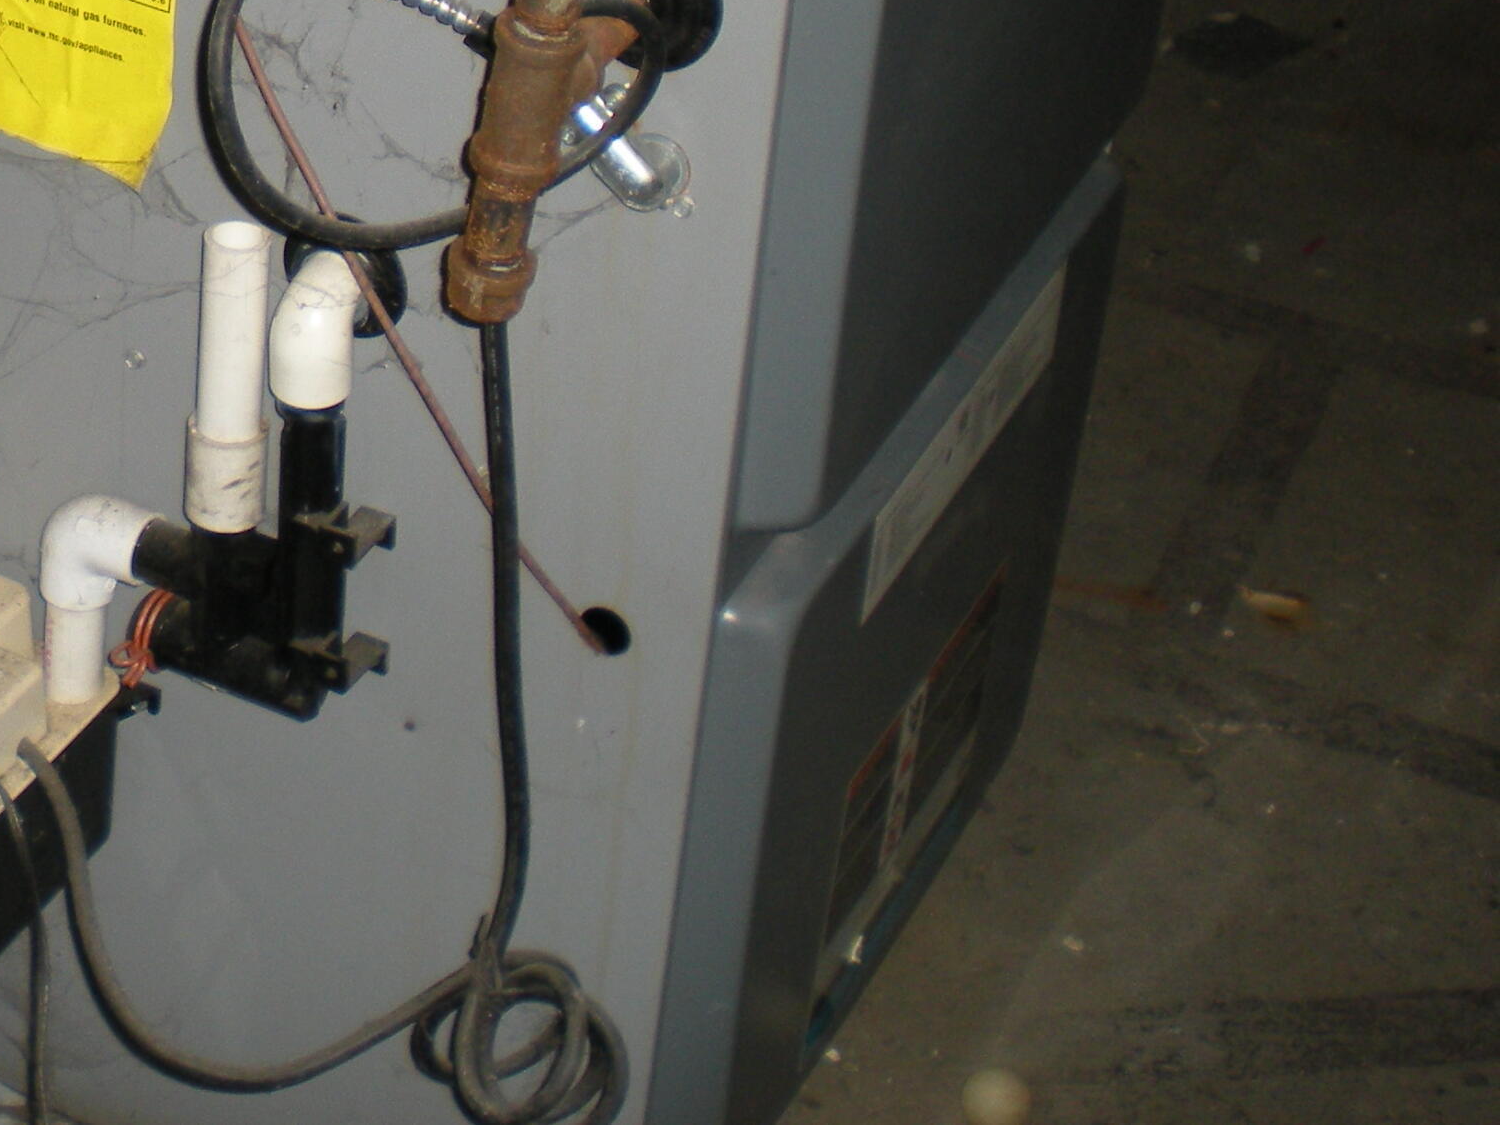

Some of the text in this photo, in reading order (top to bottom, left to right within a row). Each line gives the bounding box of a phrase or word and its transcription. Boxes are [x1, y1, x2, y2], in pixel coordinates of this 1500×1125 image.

[8, 19, 25, 32] visit
[48, 0, 79, 17] natural
[83, 11, 100, 23] gas
[103, 14, 146, 37] furnaces.
